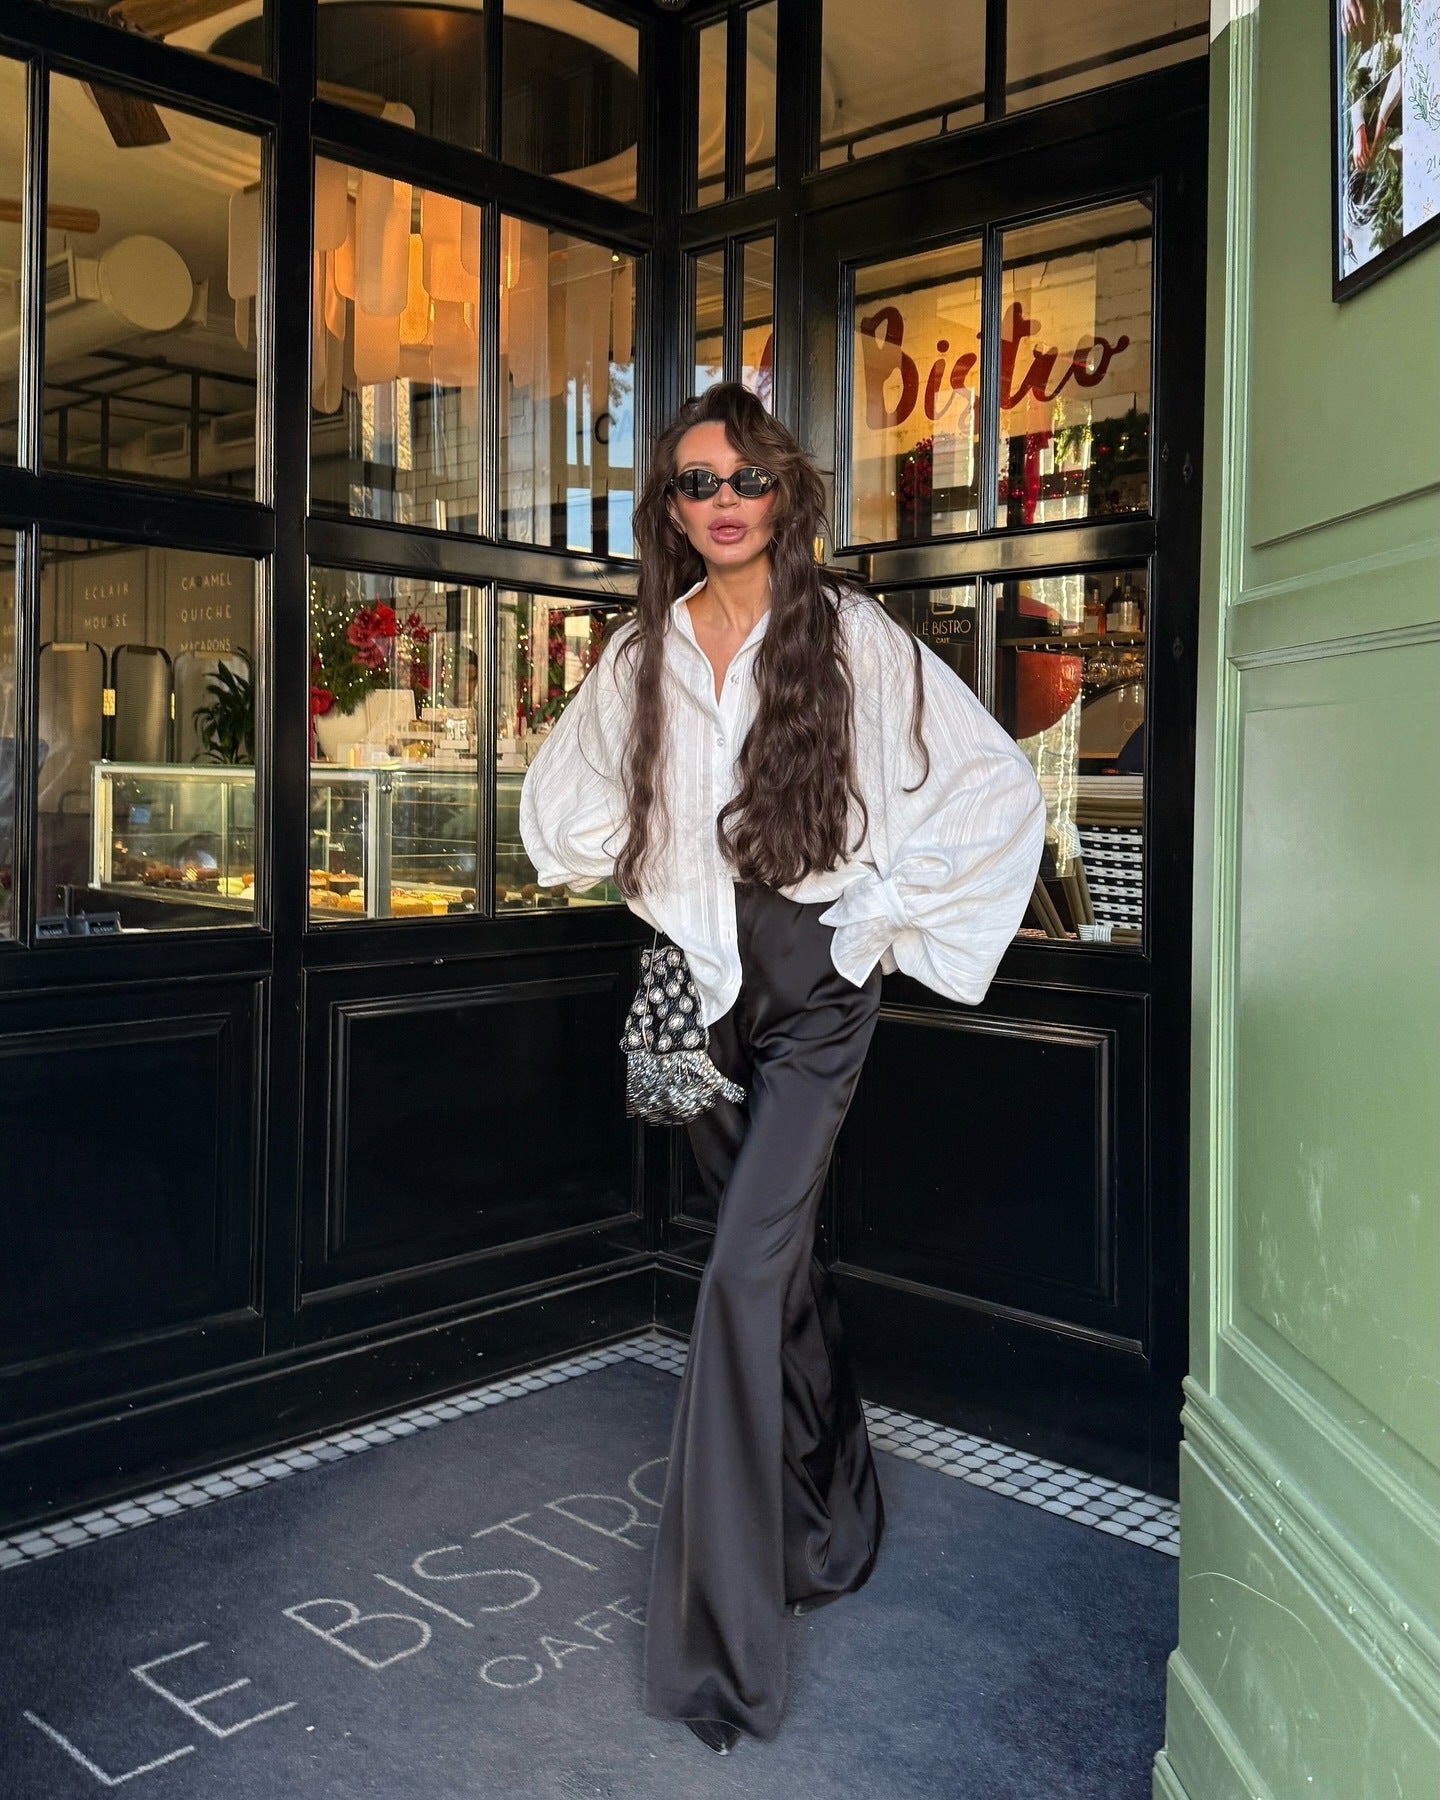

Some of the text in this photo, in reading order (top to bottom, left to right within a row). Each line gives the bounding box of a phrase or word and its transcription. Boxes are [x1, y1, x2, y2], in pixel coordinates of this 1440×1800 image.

[860, 301, 1130, 435] Bistro
[180, 604, 231, 623] QUICHE
[932, 619, 972, 635] BISTRO
[180, 637, 231, 652] MACARONS
[23, 1640, 299, 1786] LE
